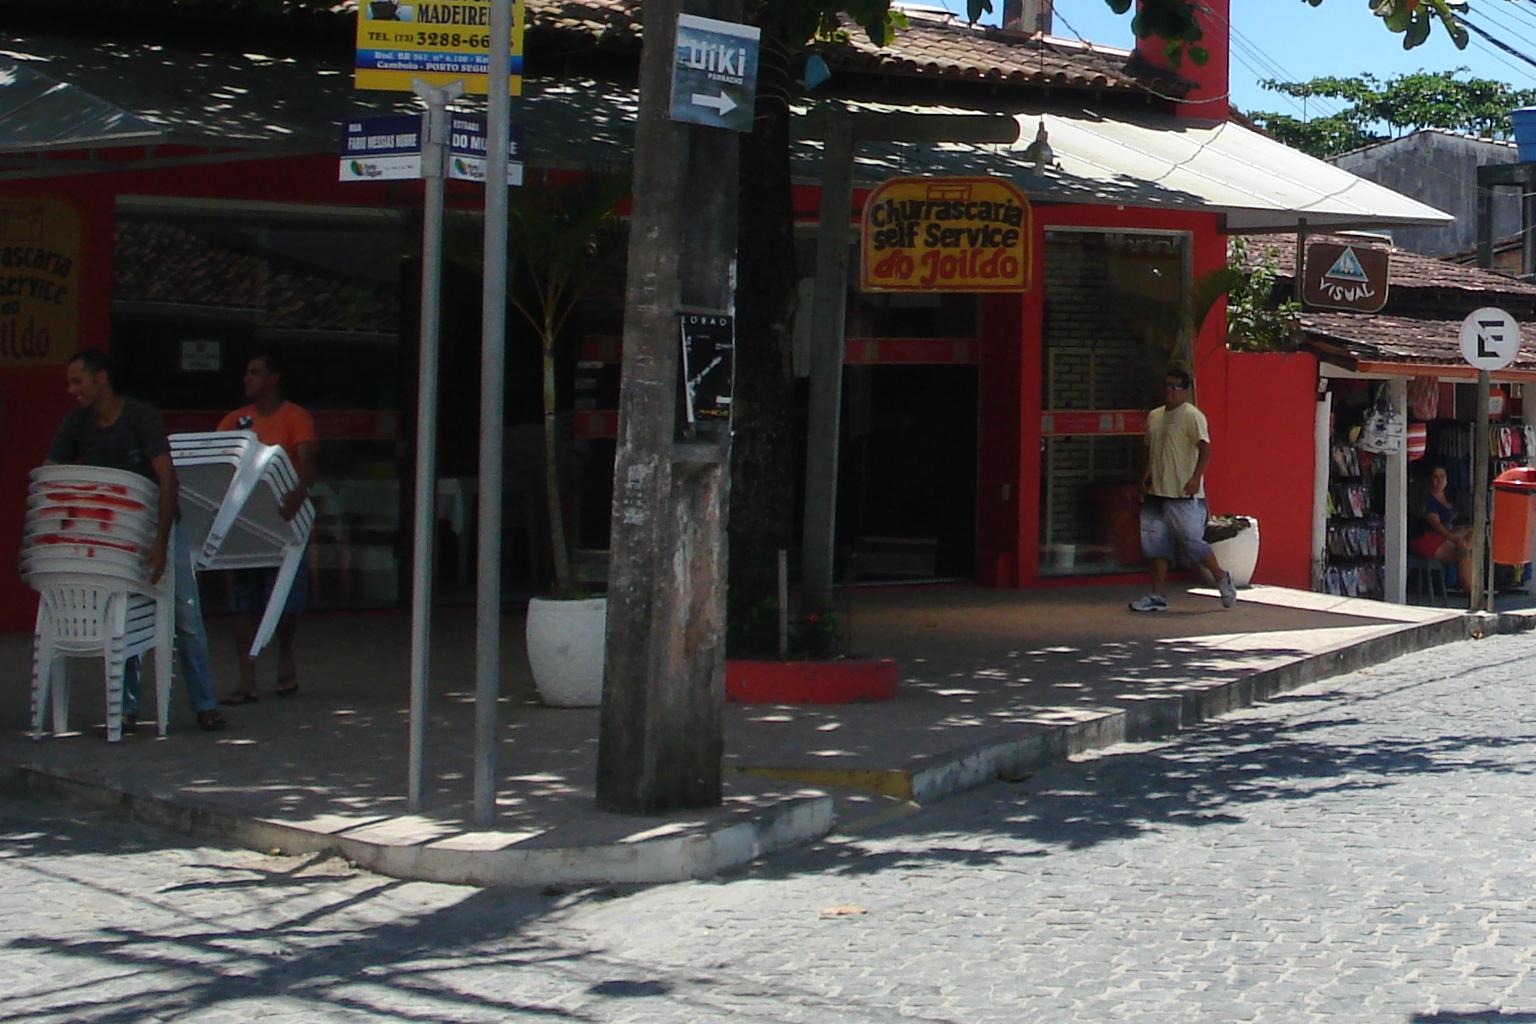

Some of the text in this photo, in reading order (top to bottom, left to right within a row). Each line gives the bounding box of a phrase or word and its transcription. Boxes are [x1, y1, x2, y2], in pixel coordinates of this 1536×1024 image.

[416, 32, 514, 49] 3288-66
[426, 63, 459, 71] PORTO
[460, 64, 489, 73] SEGU
[452, 134, 468, 148] DO
[871, 198, 1023, 227] Churrascaria
[924, 223, 1019, 248] Service
[874, 249, 914, 280] do
[1319, 276, 1375, 302] VISUAL
